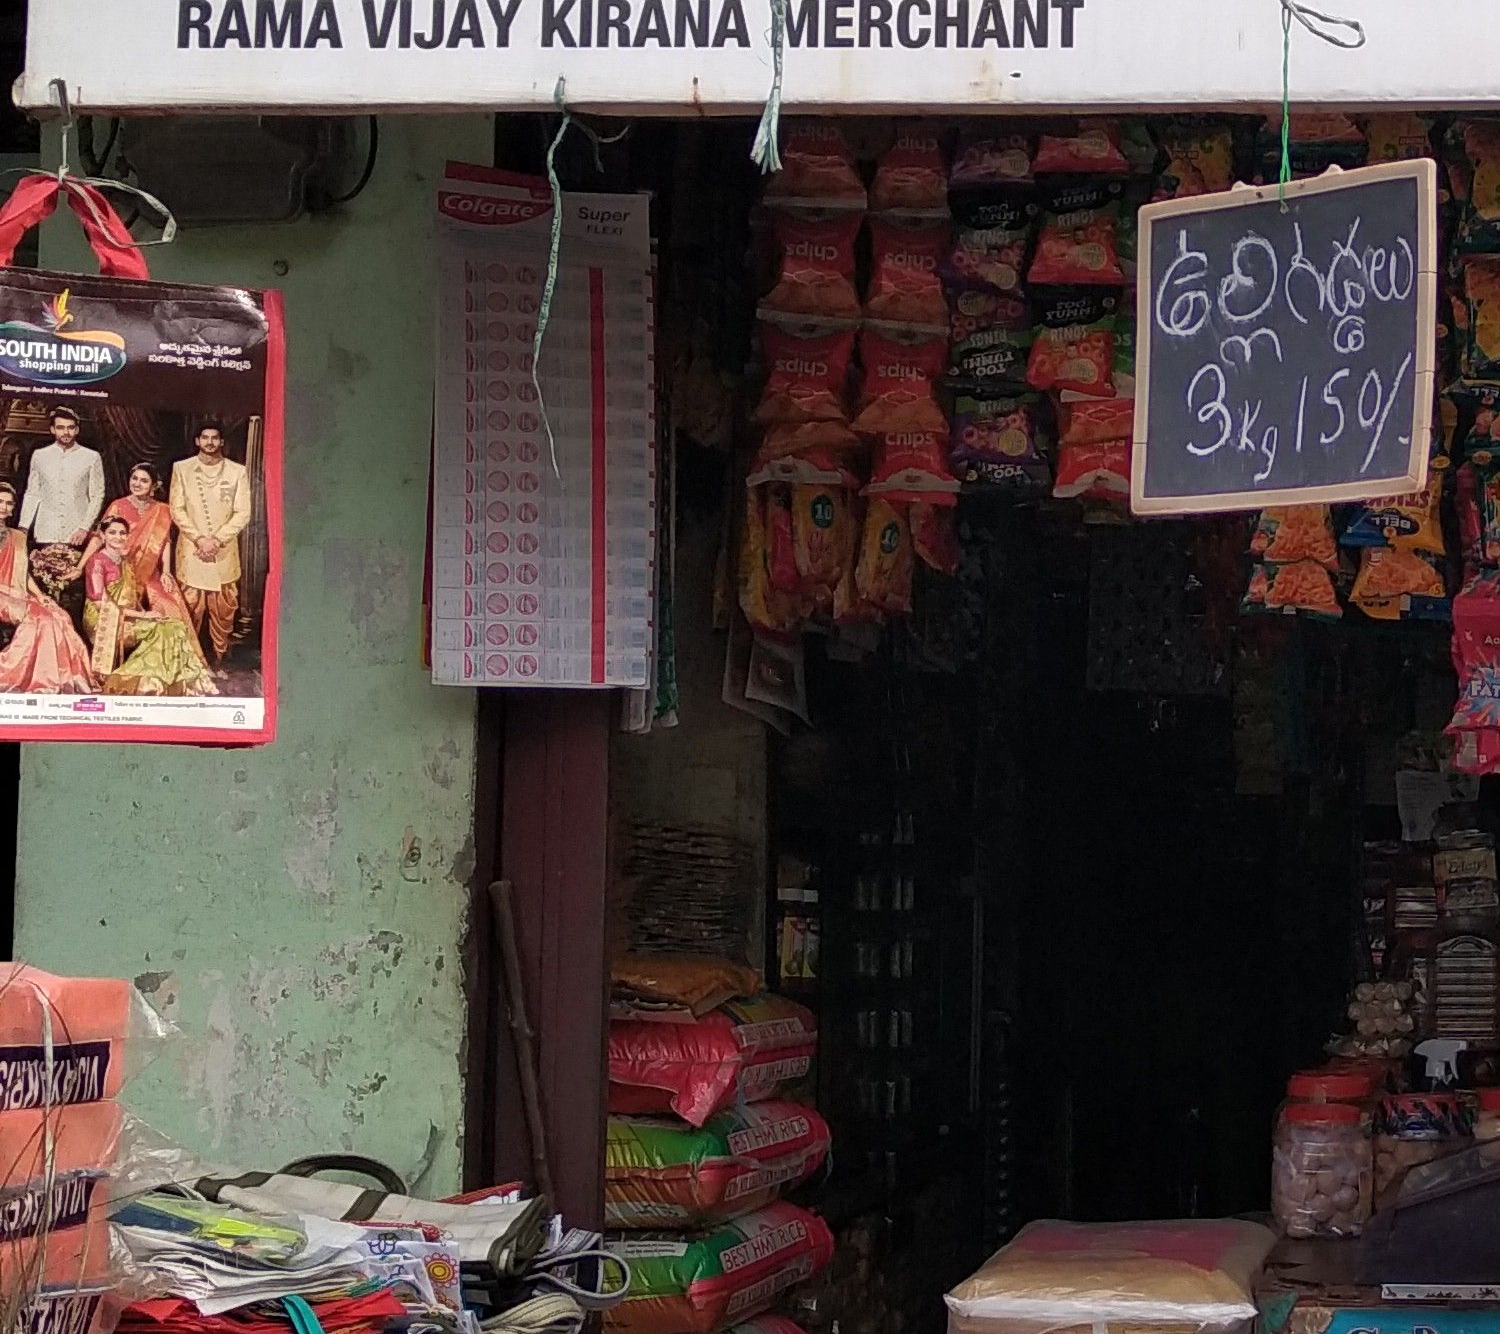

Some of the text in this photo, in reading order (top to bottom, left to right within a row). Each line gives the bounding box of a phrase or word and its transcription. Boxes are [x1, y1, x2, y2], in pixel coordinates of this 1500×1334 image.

[443, 194, 536, 218] Colgate
[577, 205, 631, 223] Super
[785, 240, 839, 261] Chips
[883, 250, 936, 271] Chips
[0, 338, 113, 365] SOUTH INDIA
[19, 358, 99, 374] shopping mall
[774, 359, 828, 377] Chips
[877, 362, 928, 381] Chips
[884, 431, 935, 446] Chips
